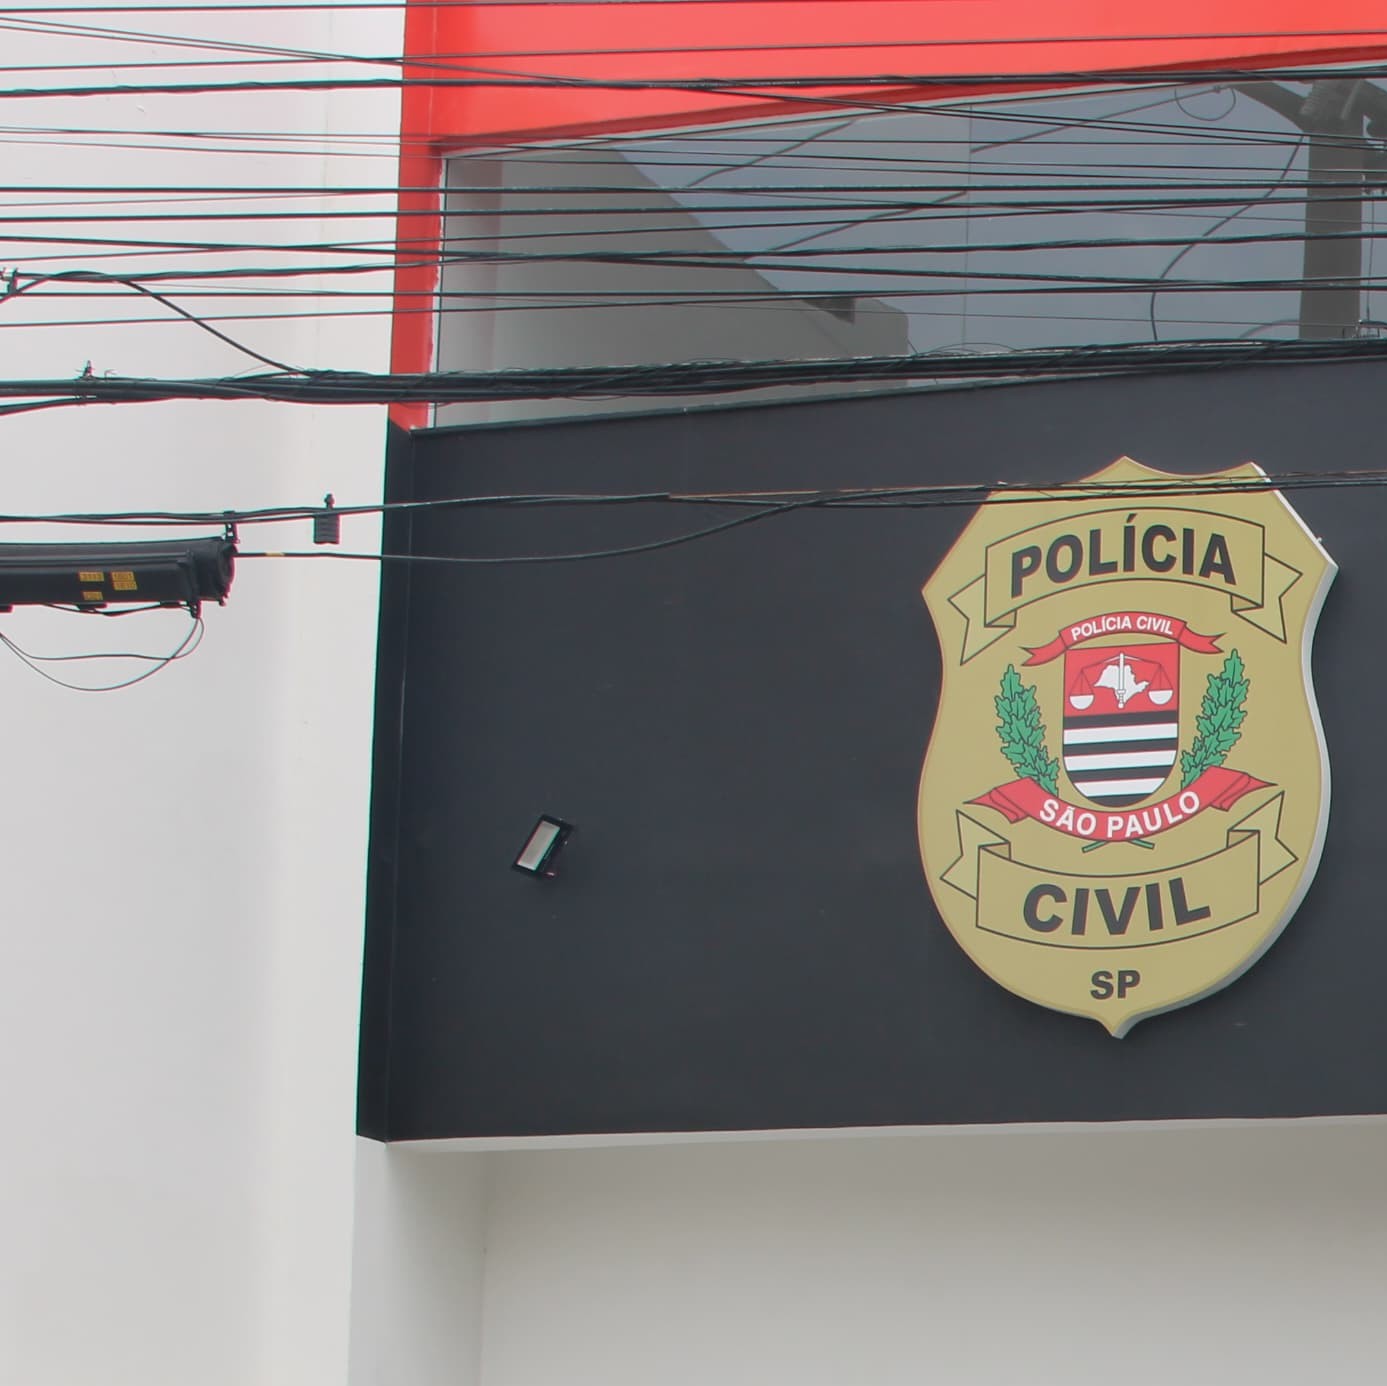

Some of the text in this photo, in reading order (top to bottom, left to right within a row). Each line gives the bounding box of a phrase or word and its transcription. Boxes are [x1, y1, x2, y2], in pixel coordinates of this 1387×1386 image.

[1010, 513, 1237, 599] POLÍCIA
[1070, 614, 1175, 641] POLÍCIA CIVIL
[1039, 790, 1201, 839] SÃO PAULO
[1022, 877, 1212, 936] CIVIL
[1089, 969, 1141, 1001] SP
